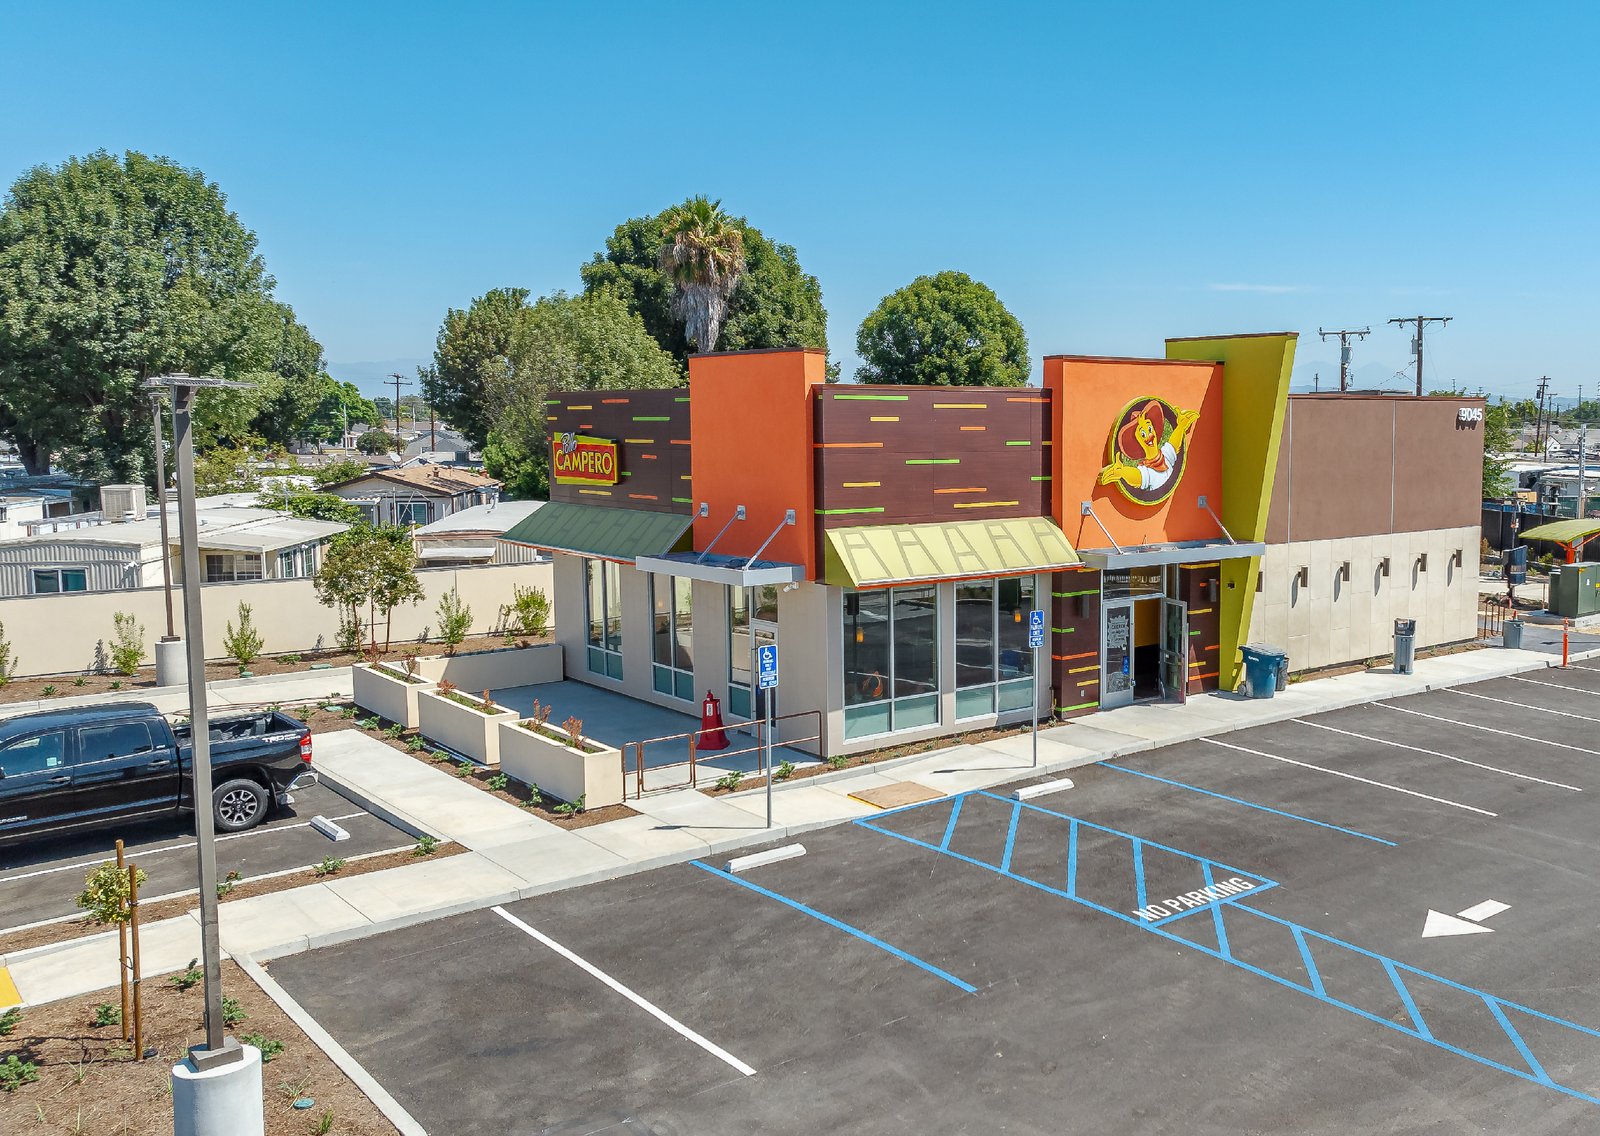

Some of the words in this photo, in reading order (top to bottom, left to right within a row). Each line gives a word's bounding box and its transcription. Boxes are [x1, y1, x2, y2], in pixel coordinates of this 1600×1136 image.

[1458, 407, 1483, 422] 9045
[556, 449, 613, 475] CAMPERO
[1131, 904, 1172, 922] NO
[1161, 877, 1257, 912] PARKING
